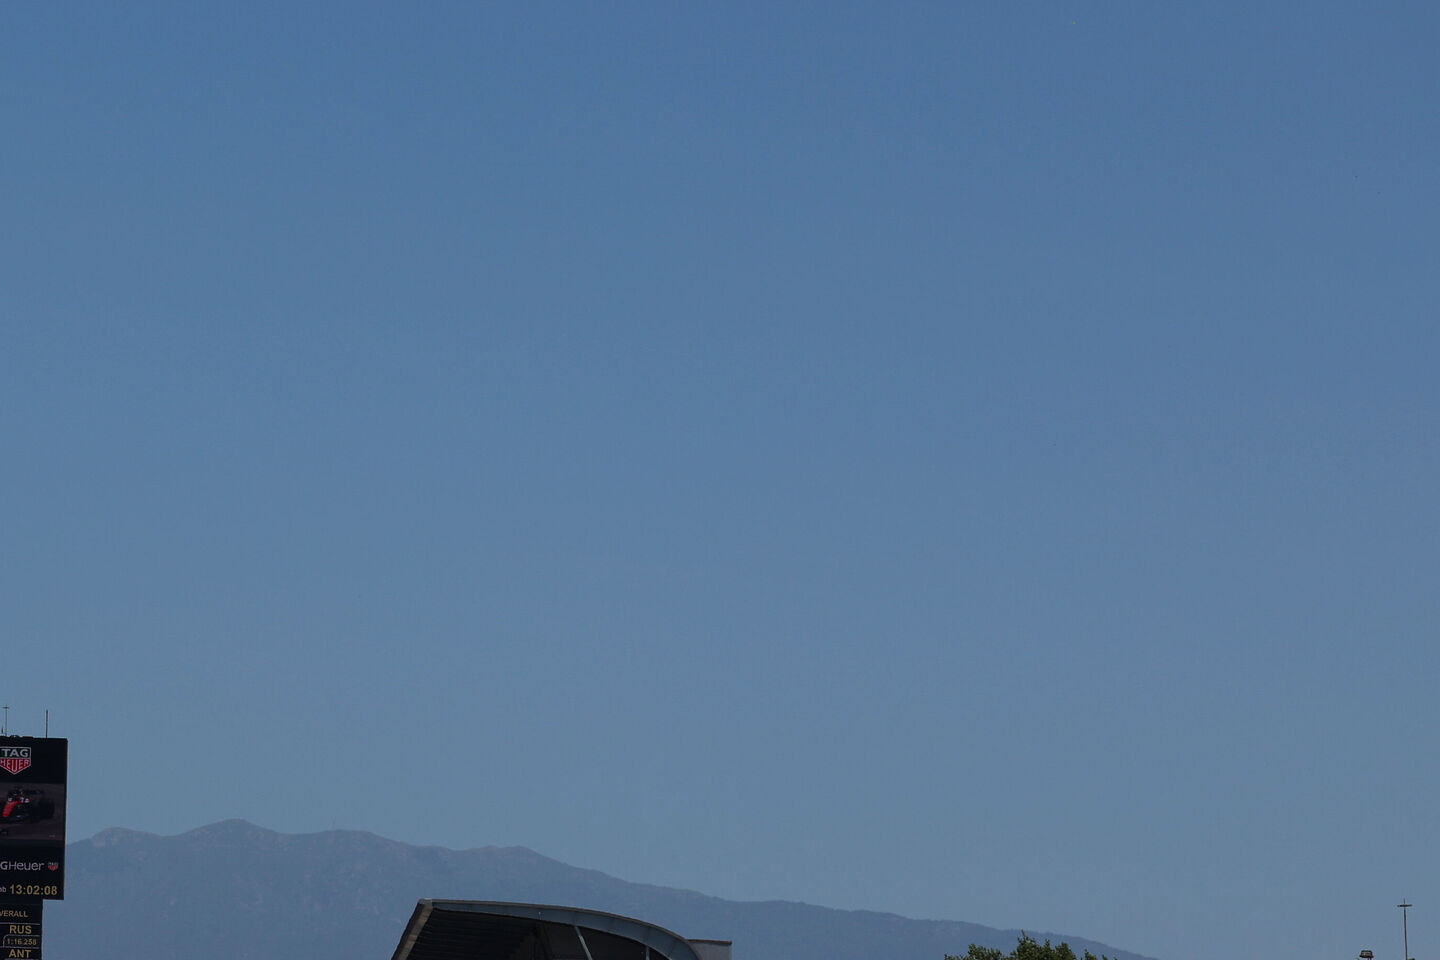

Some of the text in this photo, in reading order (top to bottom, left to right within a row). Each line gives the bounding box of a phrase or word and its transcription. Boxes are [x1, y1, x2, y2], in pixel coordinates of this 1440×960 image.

[1, 748, 28, 758] TAG
[0, 759, 29, 772] HEUER
[10, 884, 58, 895] 13:02:08
[10, 925, 32, 934] RUS
[9, 949, 31, 958] ANT
